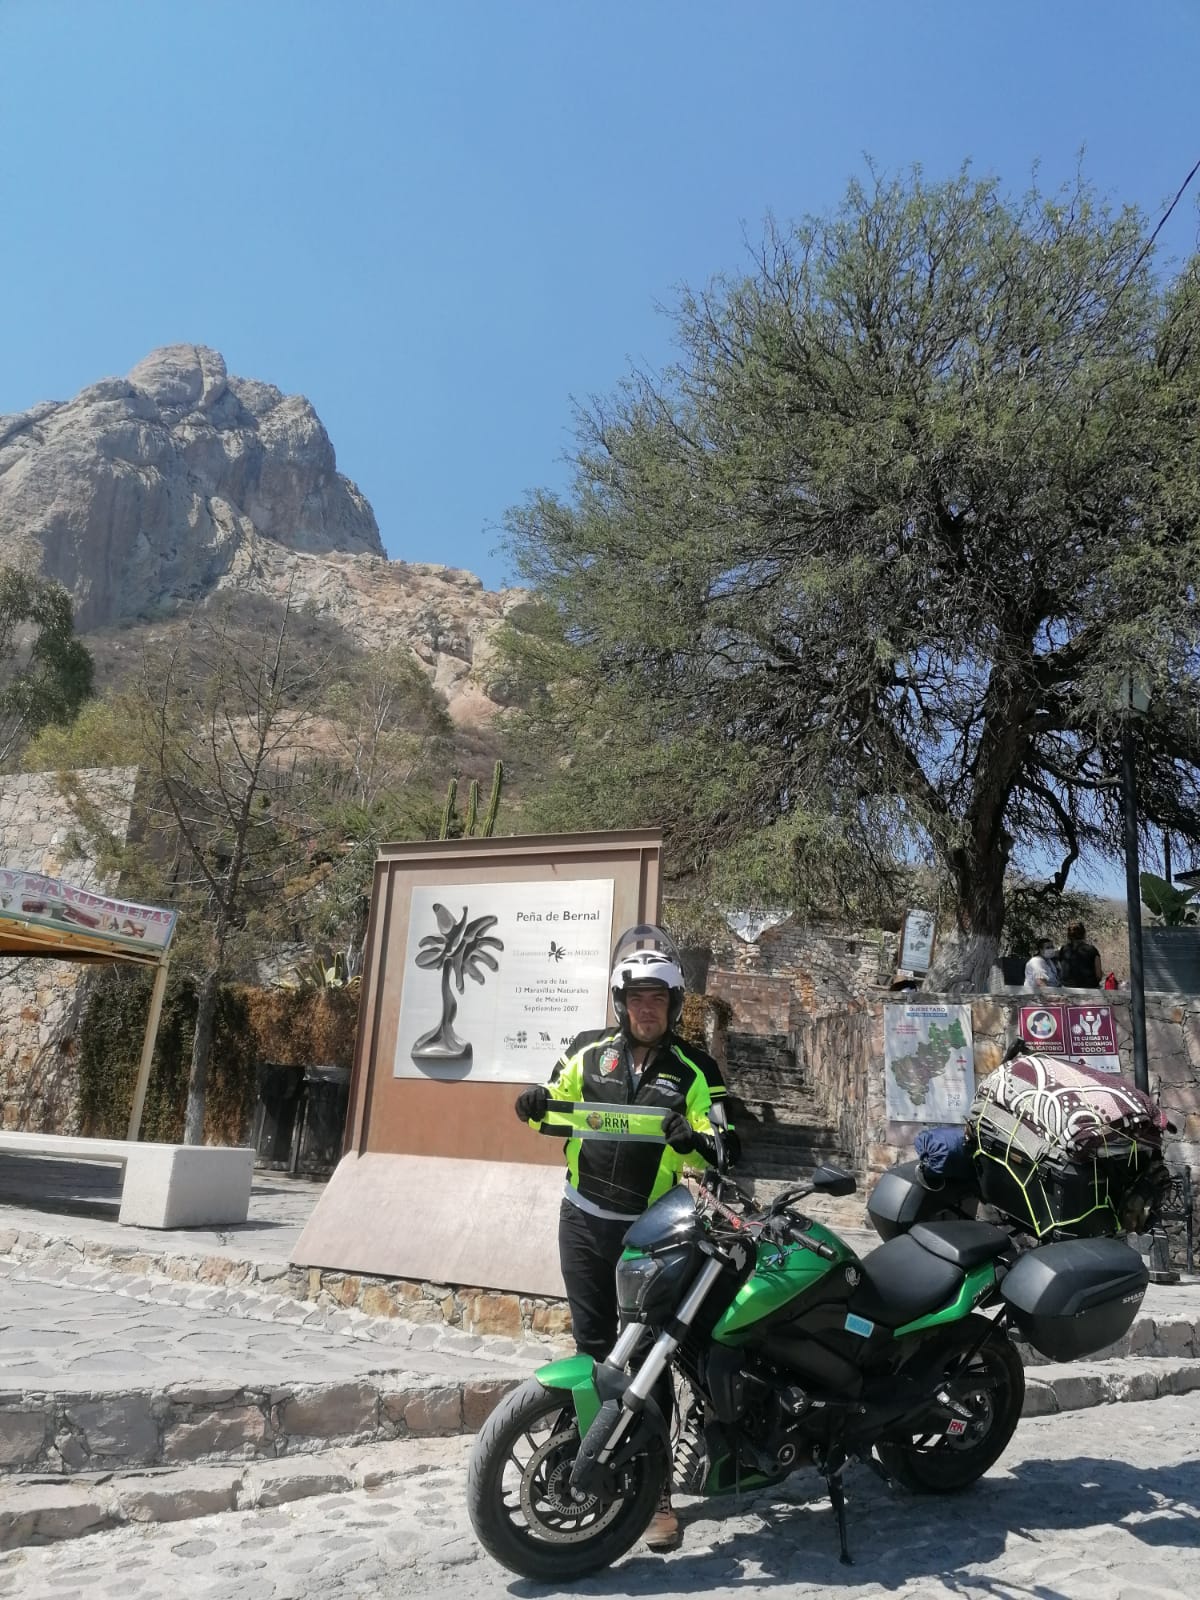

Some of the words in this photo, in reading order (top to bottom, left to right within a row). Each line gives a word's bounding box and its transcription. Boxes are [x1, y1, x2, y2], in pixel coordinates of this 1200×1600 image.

[3, 872, 16, 887] Y
[25, 877, 172, 924] MAXIPALETAS
[516, 911, 542, 922] Peña
[545, 911, 560, 921] de
[563, 910, 600, 921] Bernal
[524, 1004, 561, 1013] Septiembre
[604, 1117, 629, 1129] RRM
